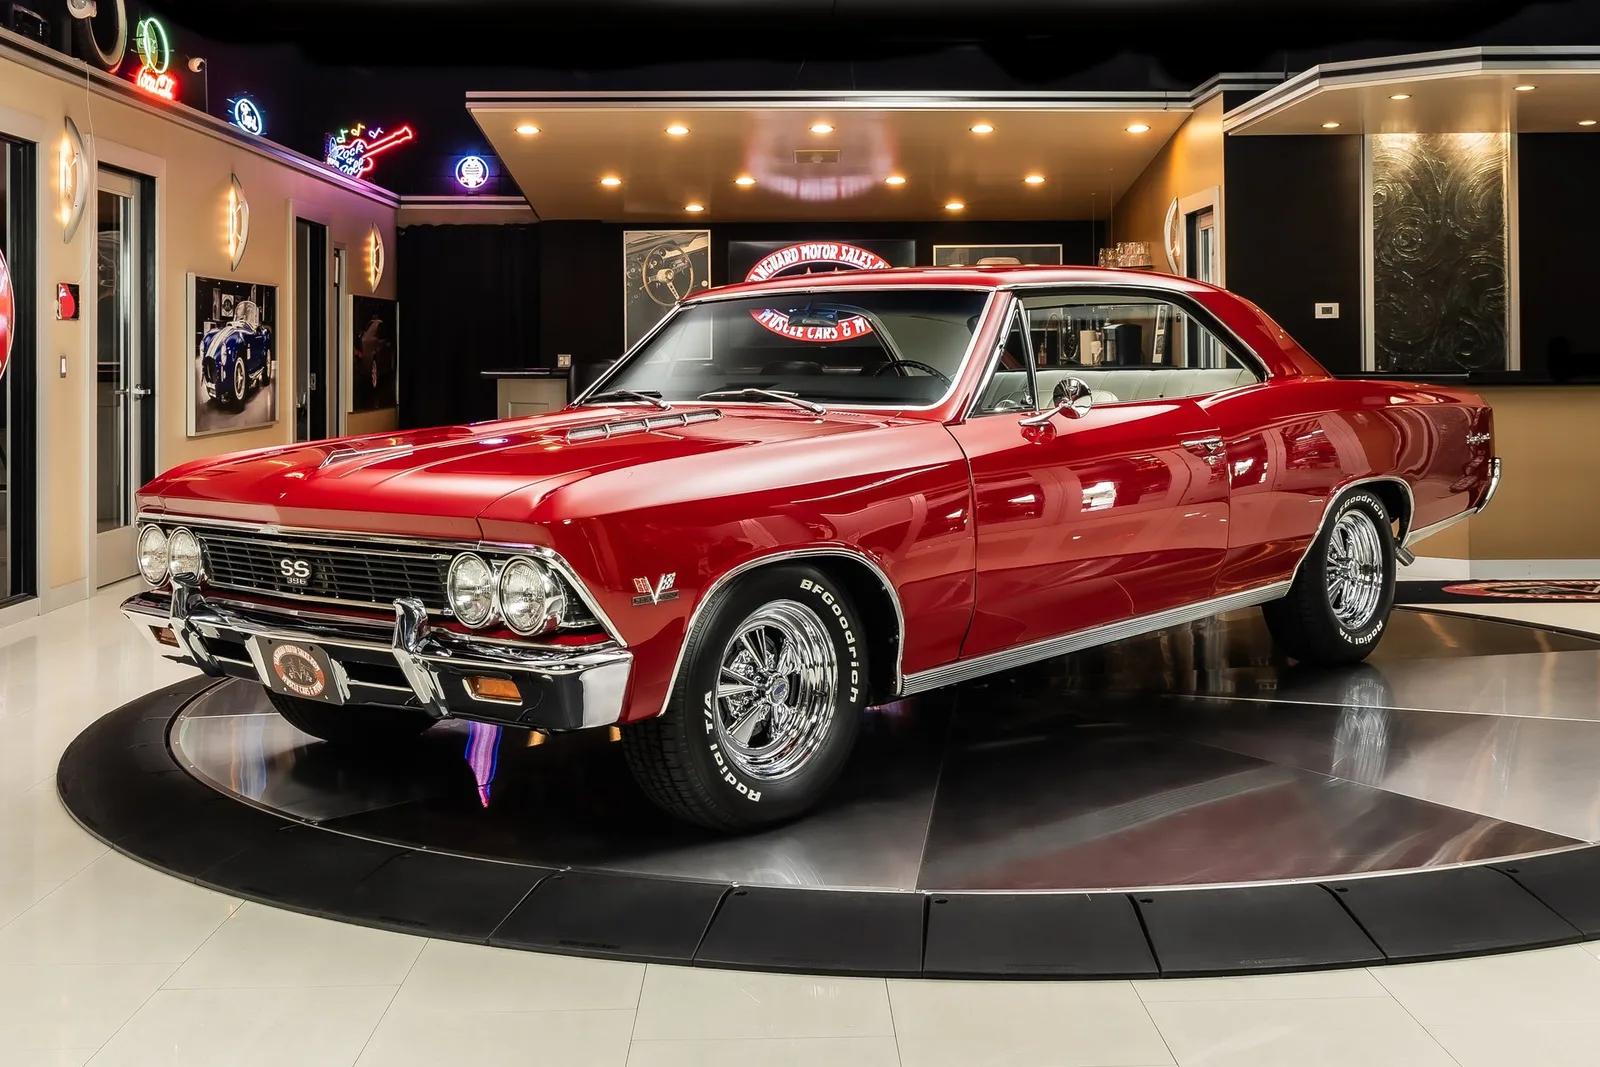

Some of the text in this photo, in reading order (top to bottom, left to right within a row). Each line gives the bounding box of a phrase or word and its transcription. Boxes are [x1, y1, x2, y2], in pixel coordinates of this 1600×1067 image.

[748, 245, 800, 282] ANGUARD
[800, 244, 838, 260] MOTOR
[758, 308, 804, 338] MUSCLE
[807, 326, 838, 339] CARS
[841, 320, 852, 337] &
[1334, 495, 1385, 523] BFGoodrich
[280, 559, 310, 578] SS
[286, 577, 308, 585] 396
[800, 578, 859, 703] BFGoodrich
[1355, 619, 1384, 645] Radial
[704, 690, 762, 802] Radial T/A
